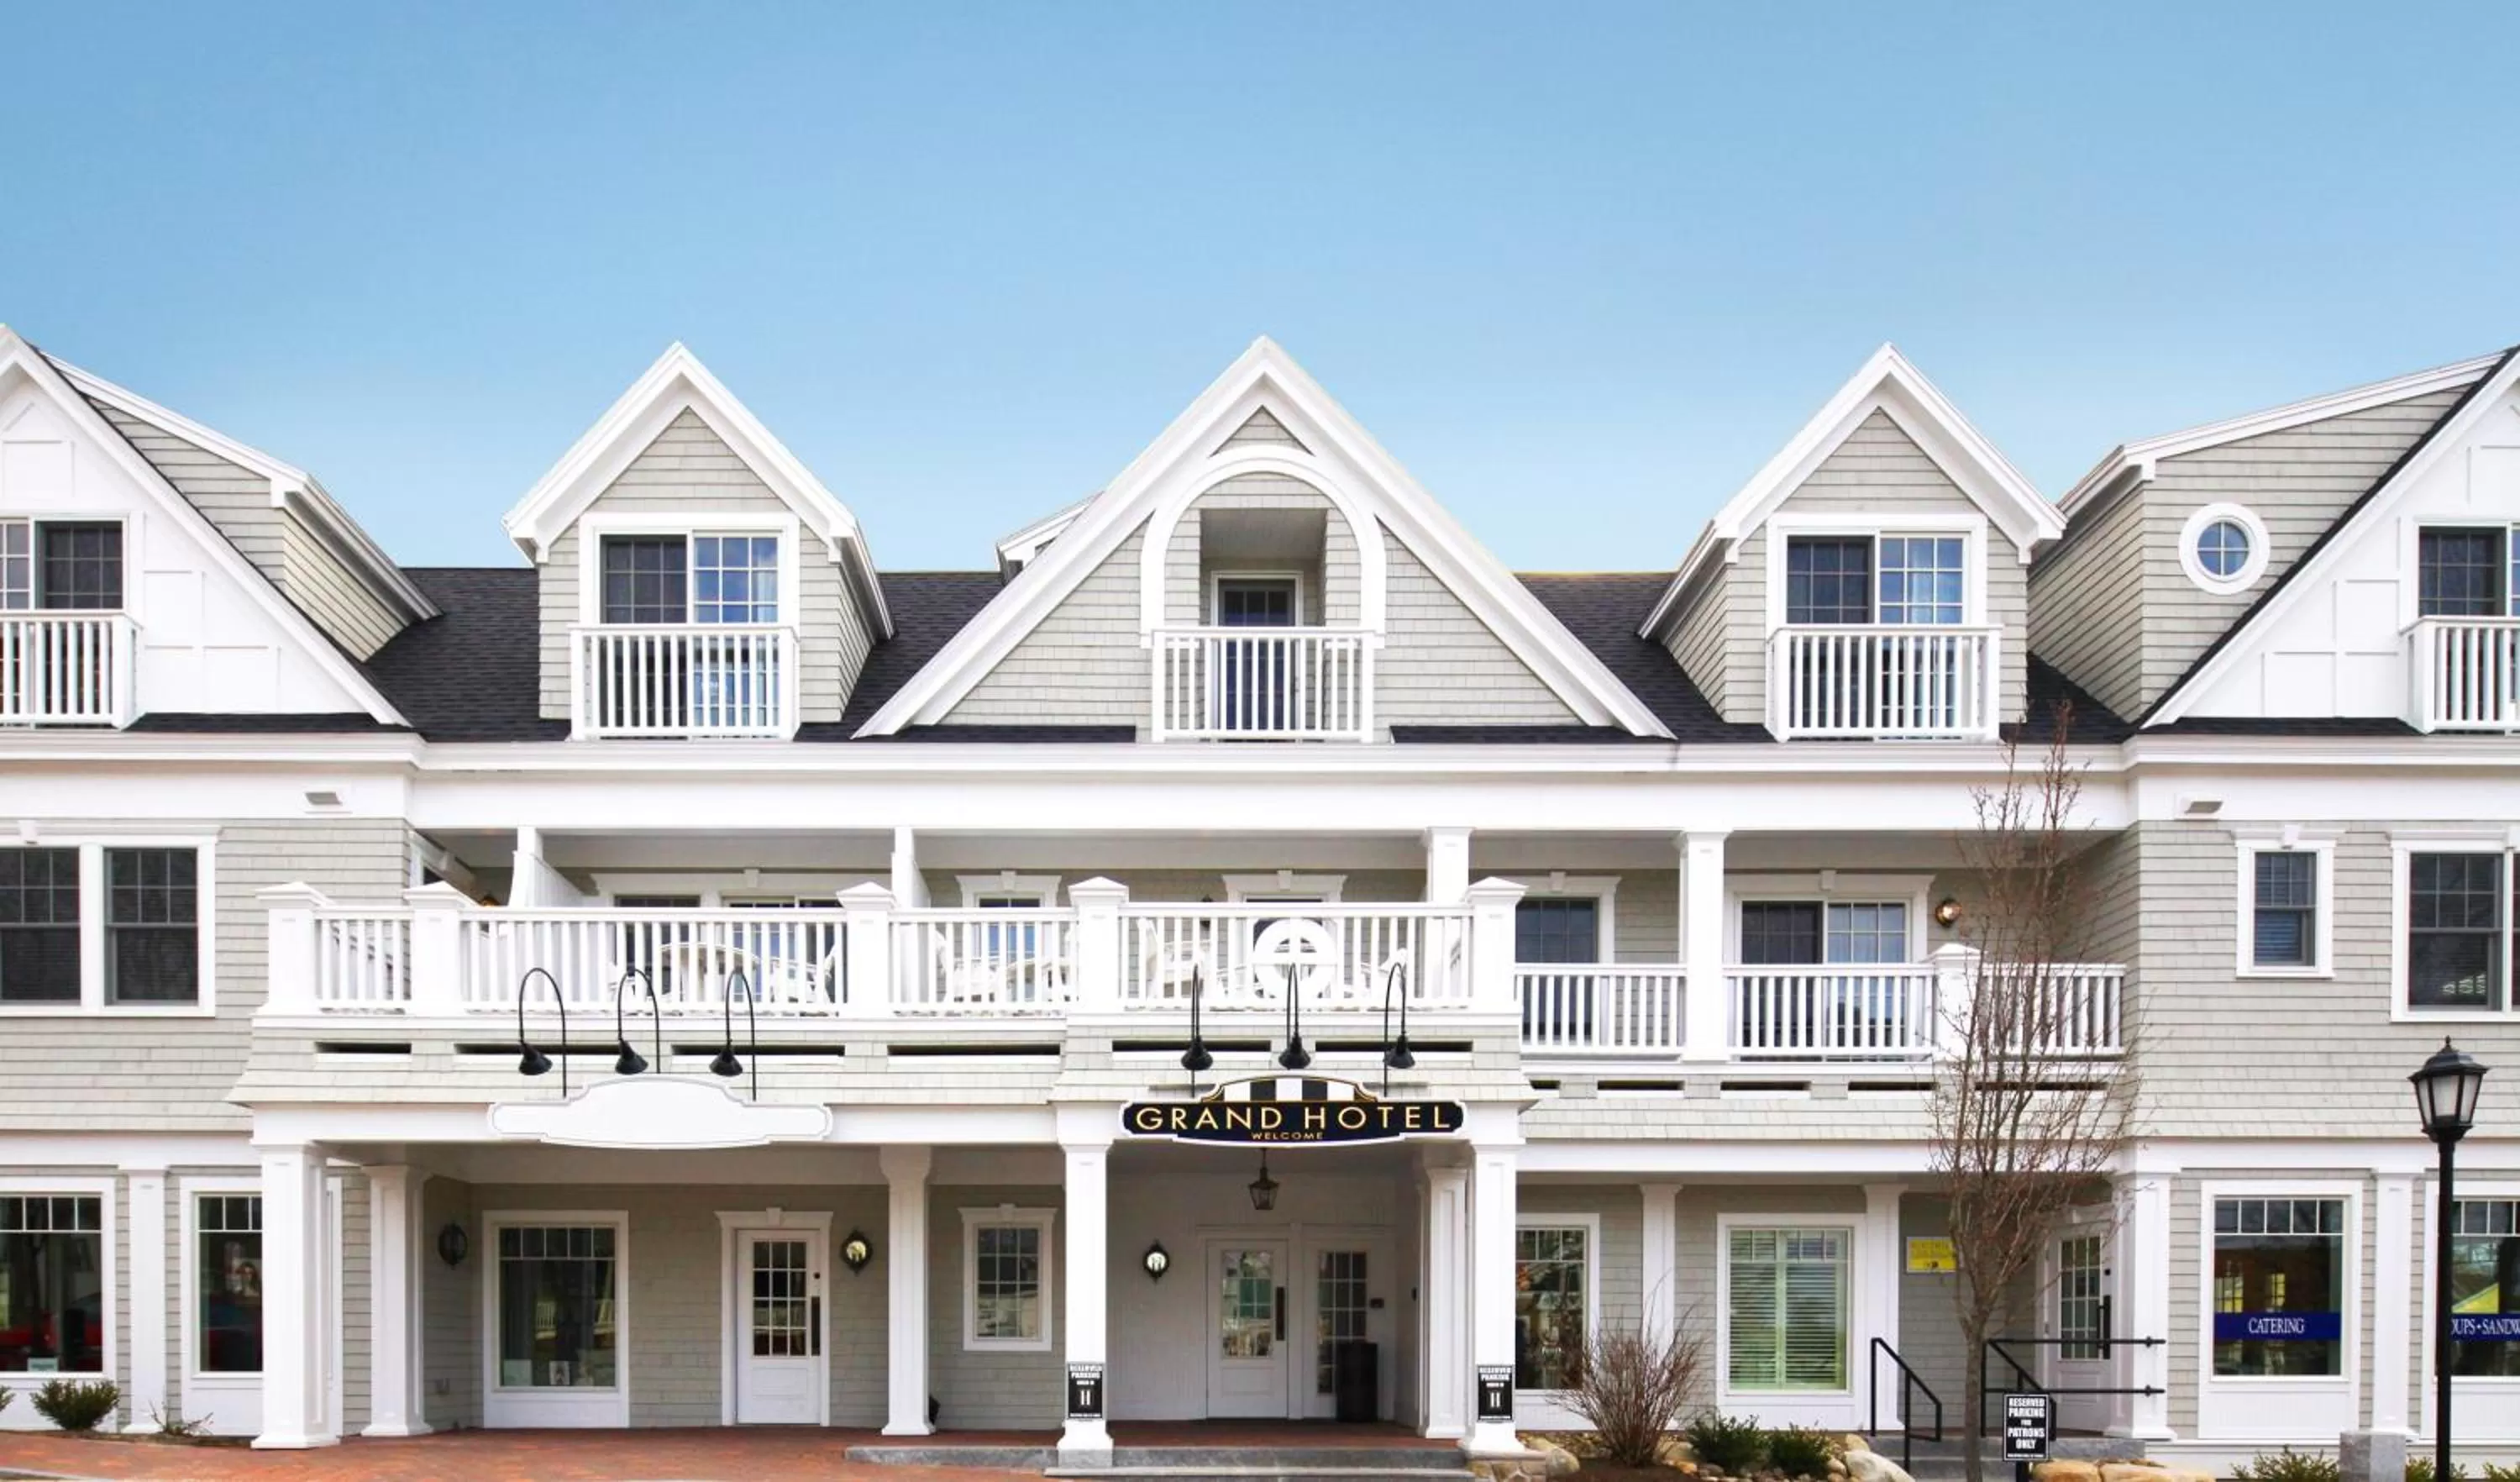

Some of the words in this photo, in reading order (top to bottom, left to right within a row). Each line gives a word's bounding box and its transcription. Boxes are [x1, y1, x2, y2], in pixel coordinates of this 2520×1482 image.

[1136, 1106, 1283, 1131] GRAND
[1304, 1106, 1451, 1130] HOTEL
[1252, 1131, 1324, 1140] WELCOME
[2248, 1316, 2305, 1334] CATERING
[2008, 1397, 2045, 1407] RESERVED
[2008, 1407, 2045, 1418] PARKING
[2008, 1427, 2045, 1438] PATRONS
[2015, 1438, 2037, 1449] ONLY
